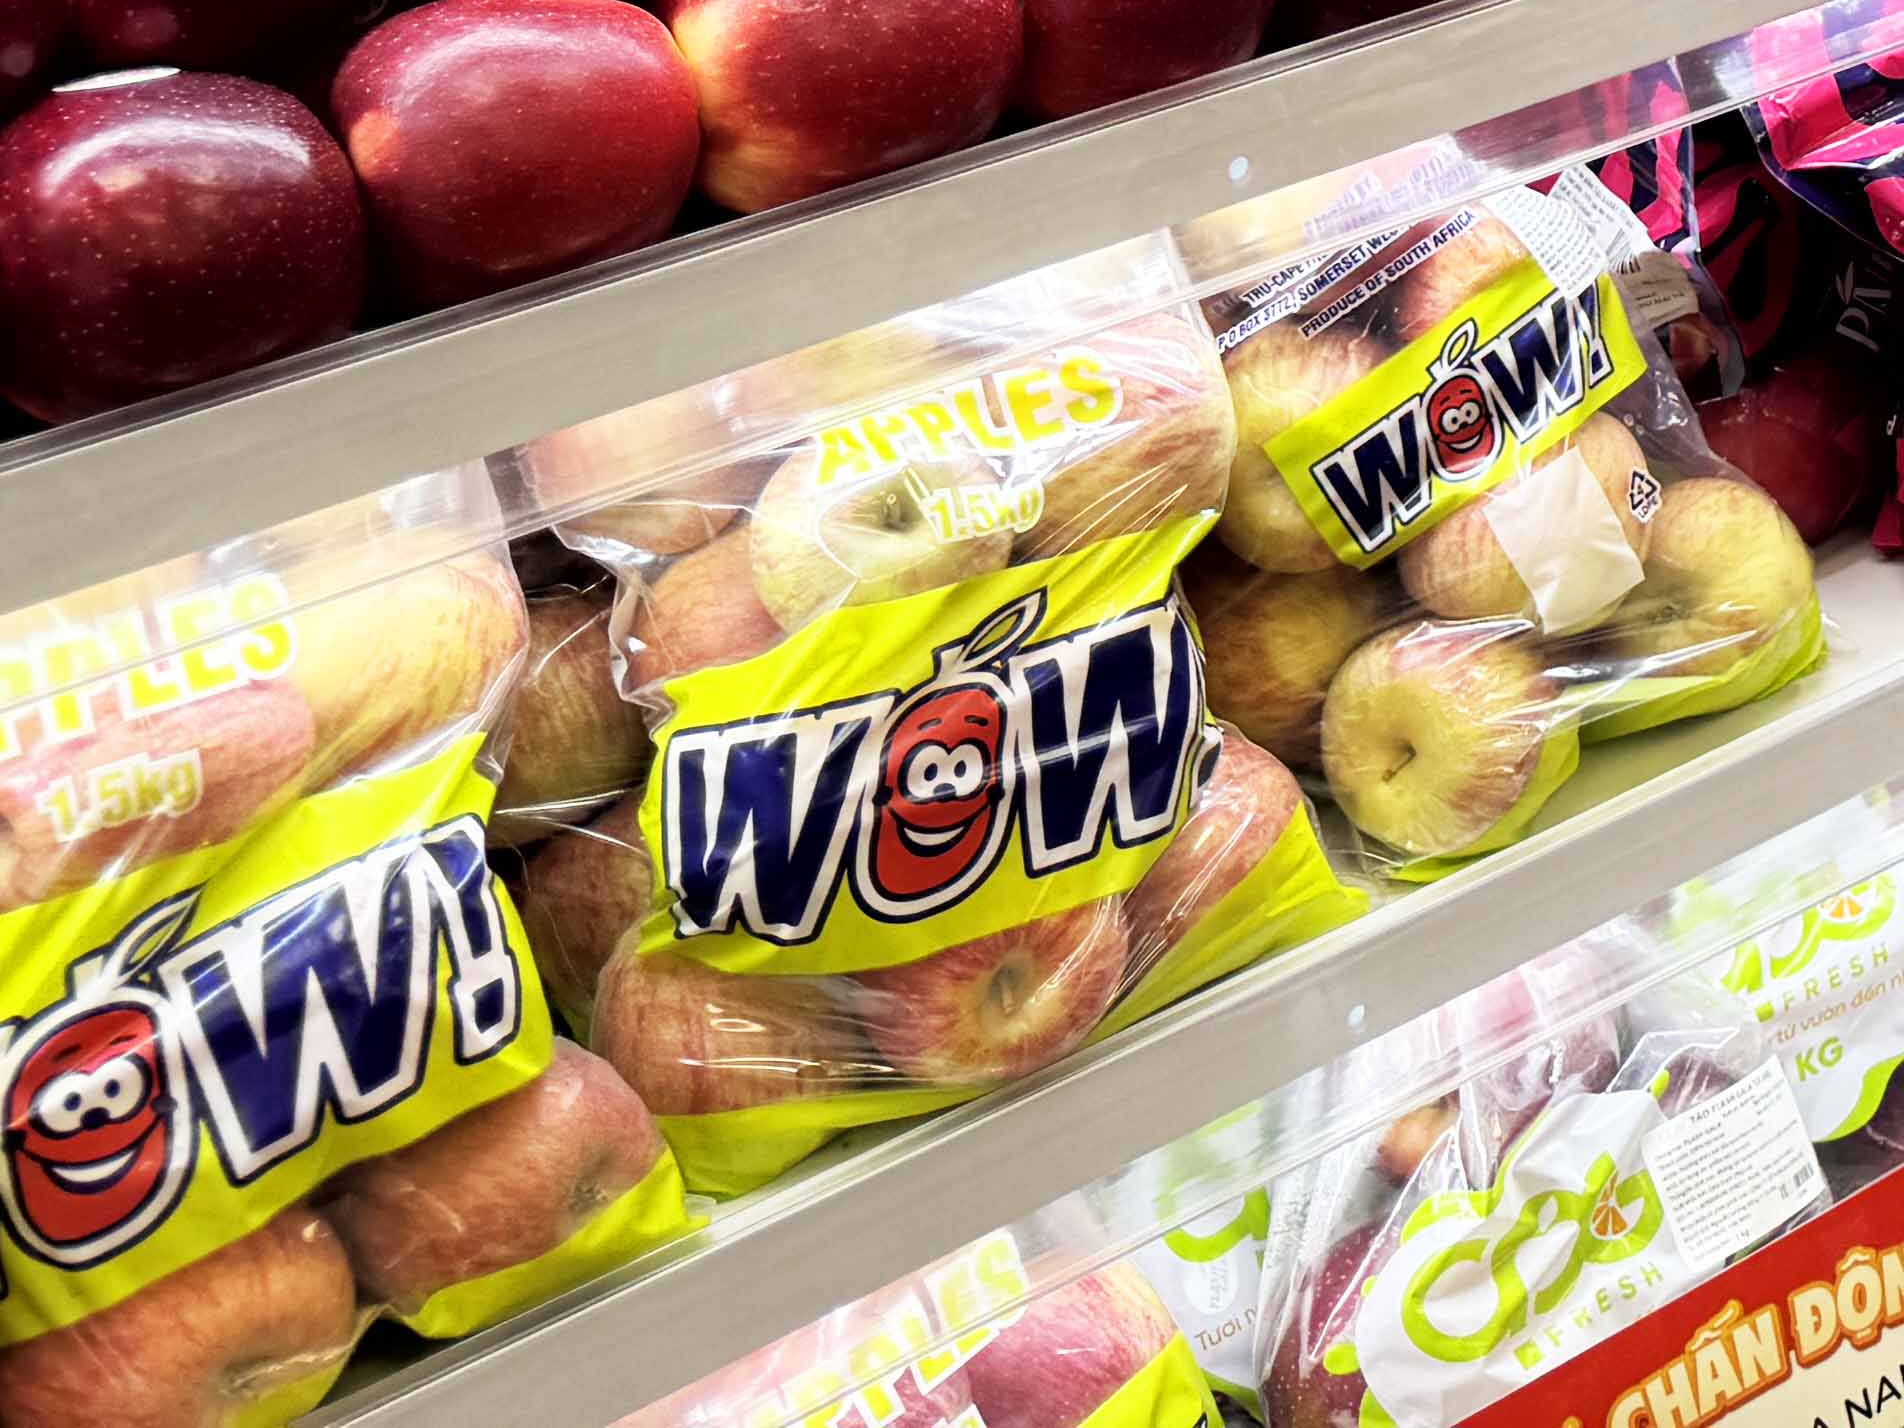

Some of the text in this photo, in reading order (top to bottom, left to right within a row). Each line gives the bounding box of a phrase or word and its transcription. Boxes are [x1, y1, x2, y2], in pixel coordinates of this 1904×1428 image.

[1298, 245, 1367, 300] SOMERSET
[1301, 209, 1476, 338] PRODUCE OF SOUTH AFRICA
[815, 354, 1122, 492] APPLES
[1311, 278, 1611, 554] WOW!
[1783, 947, 1890, 1013] FRESH
[1794, 1036, 1844, 1083] KG
[1546, 1261, 1665, 1351] FRESH
[1607, 1300, 1788, 1428] CHẤN
